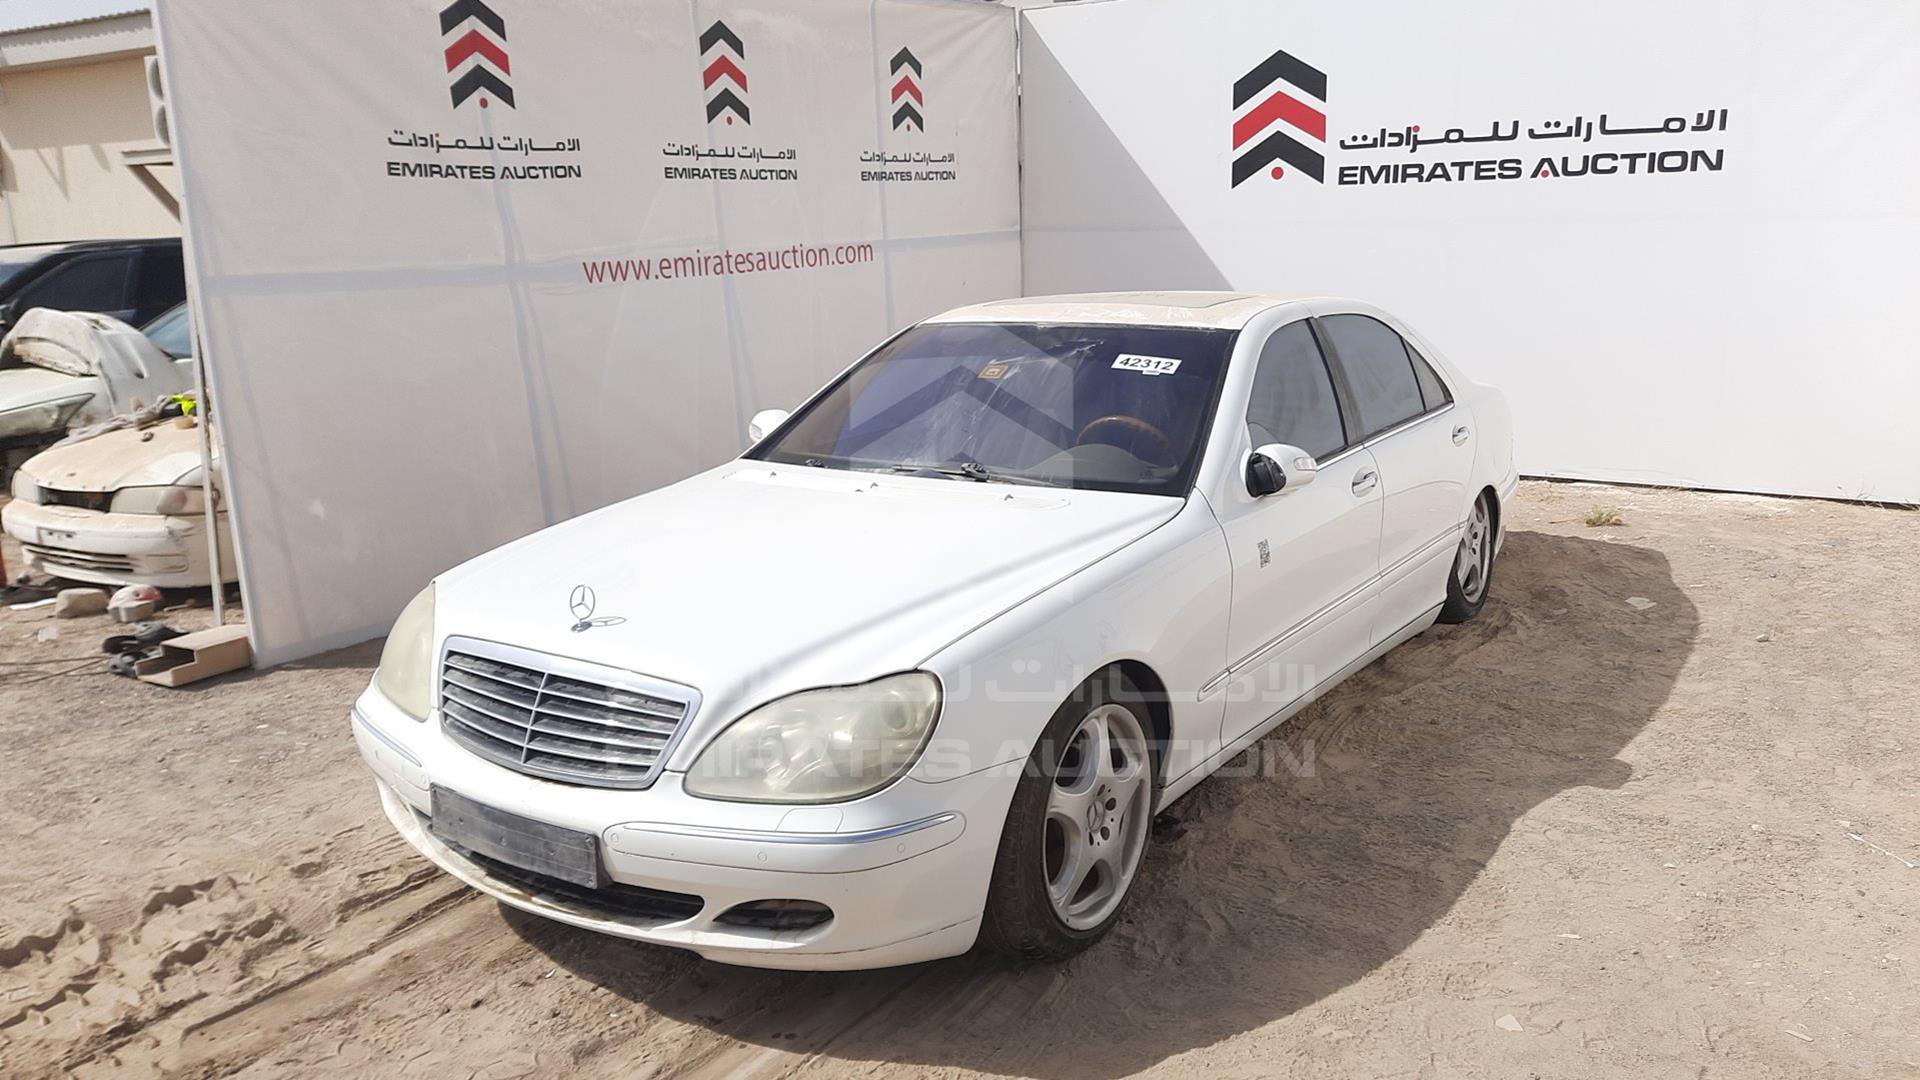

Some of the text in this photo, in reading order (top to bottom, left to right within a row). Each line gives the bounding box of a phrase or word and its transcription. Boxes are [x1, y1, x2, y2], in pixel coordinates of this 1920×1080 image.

[387, 161, 582, 180] EMIRATES AUCTION
[664, 166, 798, 181] EMIRATES AUCTION
[861, 170, 956, 181] EMIRATES AUCTION
[1338, 148, 1724, 186] EMIRATES AUCTION
[582, 243, 874, 284] www.emiratesauction.com
[1118, 357, 1174, 371] 42312
